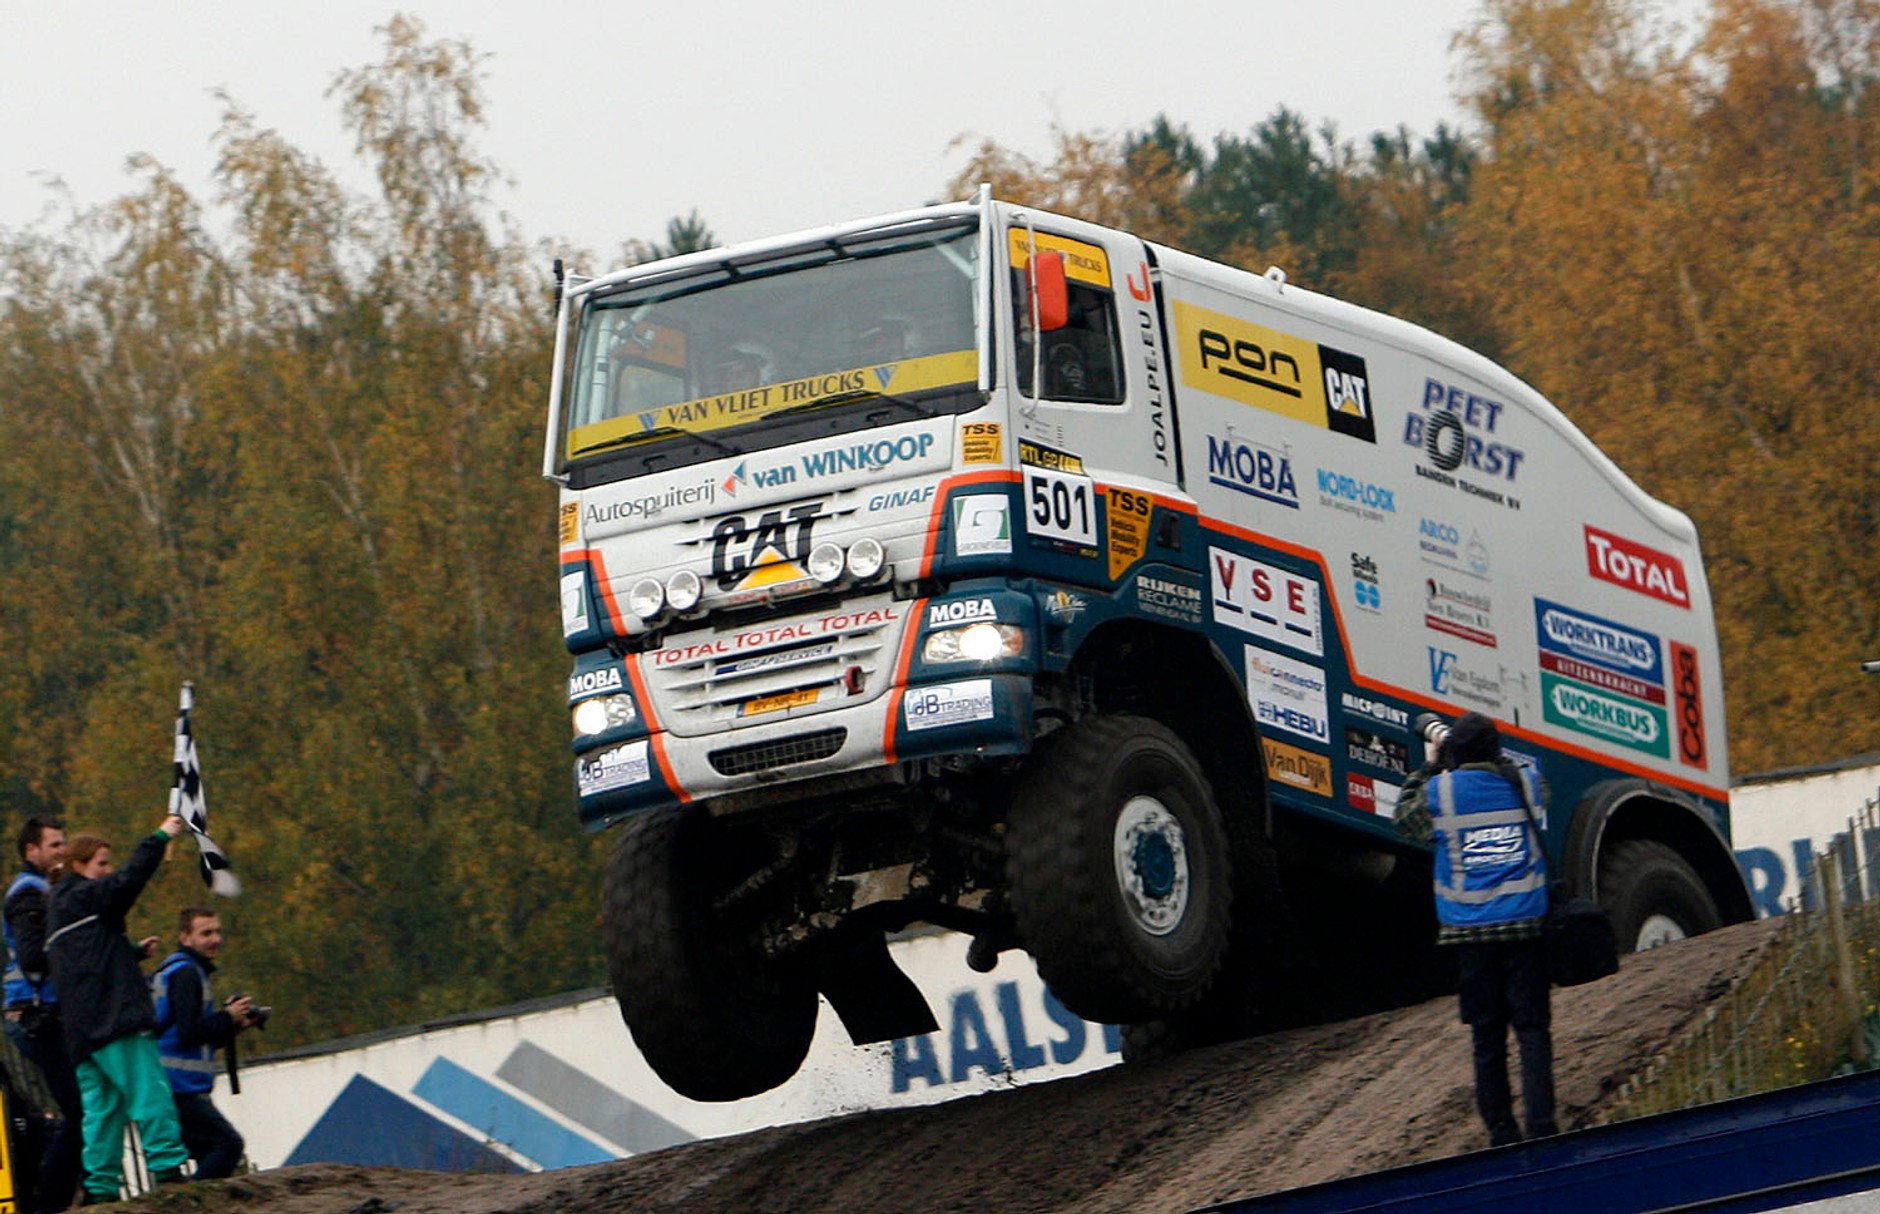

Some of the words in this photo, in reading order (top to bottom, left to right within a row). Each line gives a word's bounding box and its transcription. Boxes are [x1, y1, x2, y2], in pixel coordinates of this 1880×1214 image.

[667, 404, 708, 425] VAN
[714, 387, 772, 414] VLIET
[781, 370, 866, 403] TRUCKS
[1325, 367, 1367, 419] CAT
[1422, 376, 1504, 434] PEET
[962, 423, 1000, 436] TSS
[1402, 409, 1525, 481] BORST
[586, 478, 716, 525] Autospuiterij
[752, 463, 797, 489] van
[801, 432, 934, 479] WINKOOP
[1206, 433, 1299, 499] MOBA
[867, 486, 936, 512] GINAF
[1030, 475, 1089, 535] 501
[1109, 488, 1149, 516] TSS
[711, 501, 826, 592] CAT
[1350, 551, 1378, 575] Safe
[1587, 533, 1688, 601] TOTAL
[652, 639, 729, 667] TOTAL
[733, 624, 812, 649] TOTAL
[818, 606, 899, 633] TOTAL
[929, 598, 997, 623] MOBA
[1548, 613, 1648, 662] WORKTRANS
[570, 667, 622, 696] MOBA
[914, 694, 940, 716] dB
[1272, 704, 1326, 738] HEBU
[1560, 687, 1650, 735] WORKBUS
[889, 979, 1123, 1094] AALS
